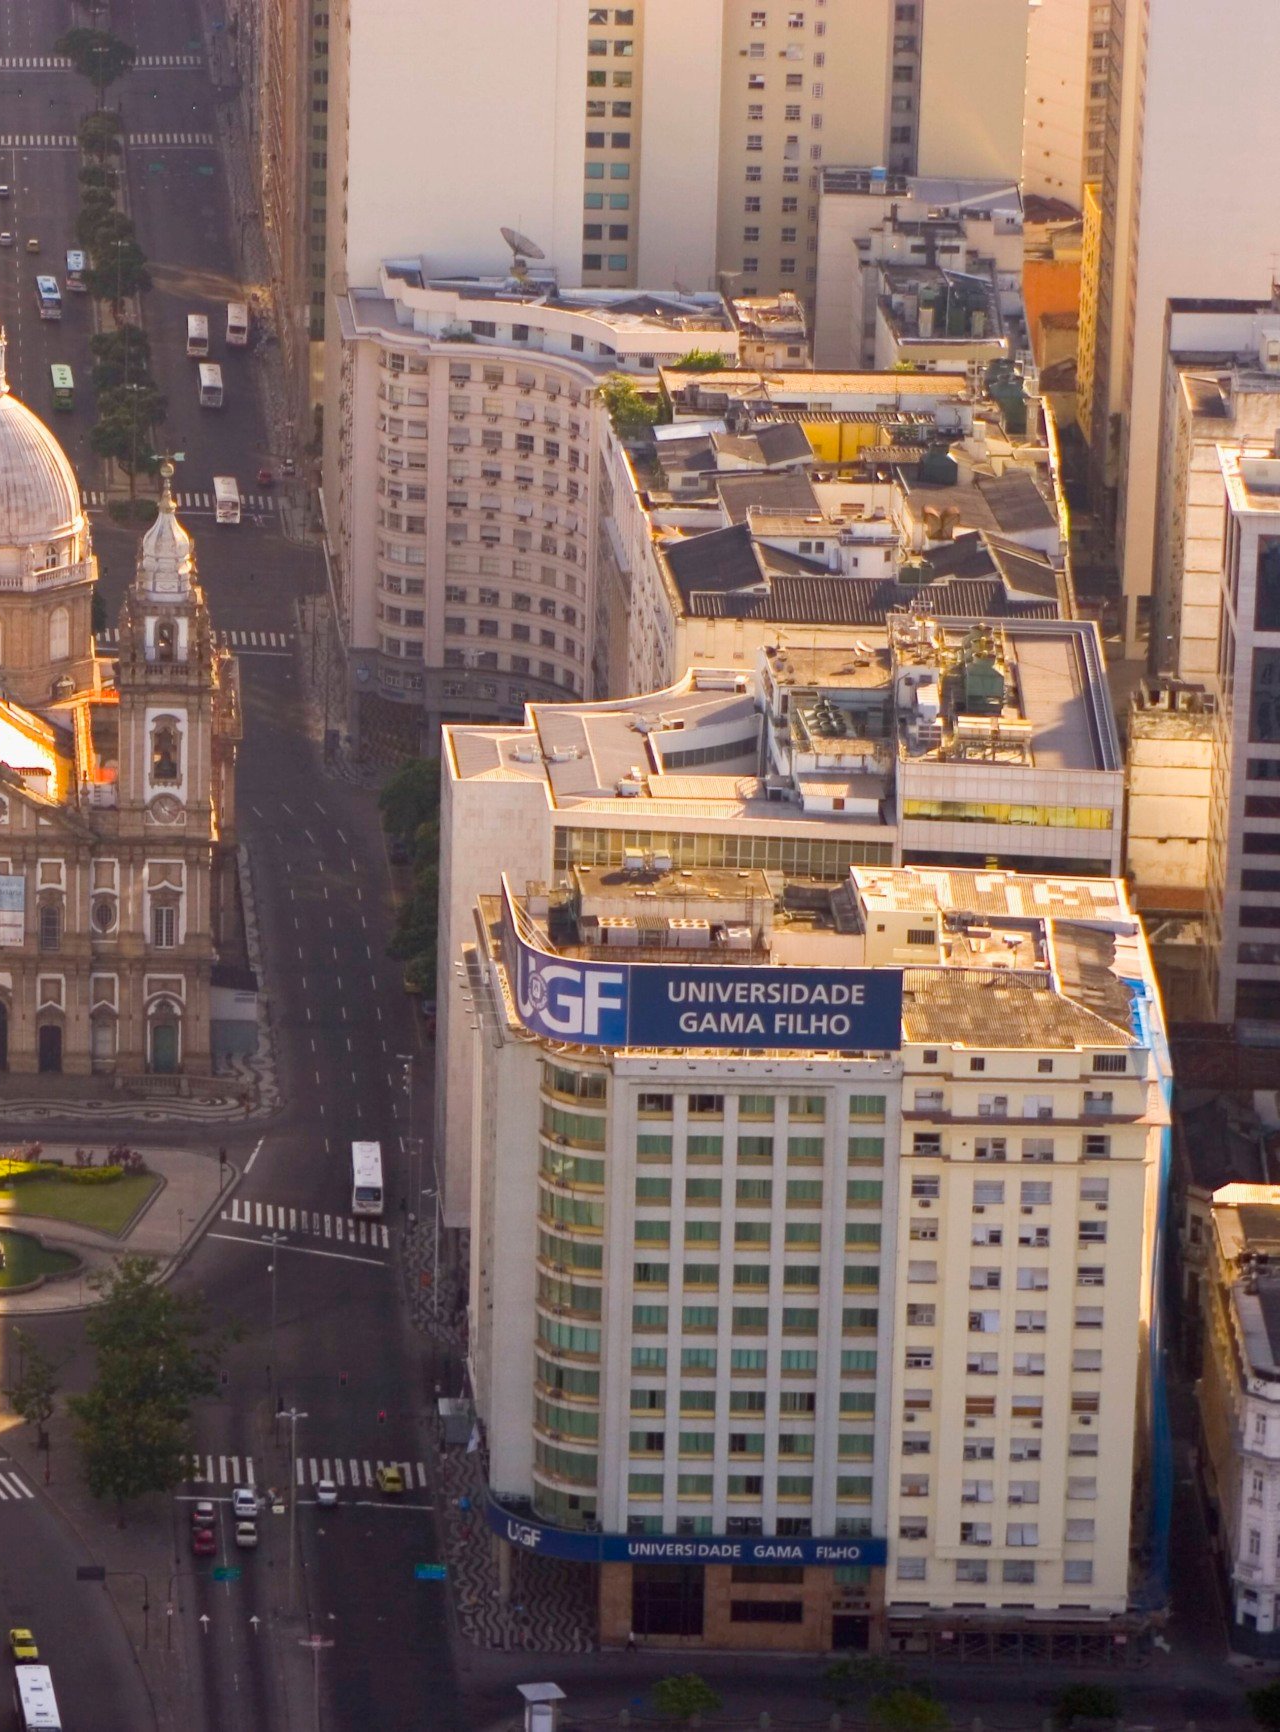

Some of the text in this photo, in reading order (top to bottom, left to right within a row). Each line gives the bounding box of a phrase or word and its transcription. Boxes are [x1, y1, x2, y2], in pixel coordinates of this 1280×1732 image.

[515, 943, 623, 1036] UGF
[667, 981, 865, 1005] UNIVERSIDADE
[679, 1012, 851, 1036] GAMA FILHO
[507, 1519, 542, 1547] UGF
[628, 1543, 741, 1558] UNIVERSIDADE
[753, 1544, 803, 1559] GAMA
